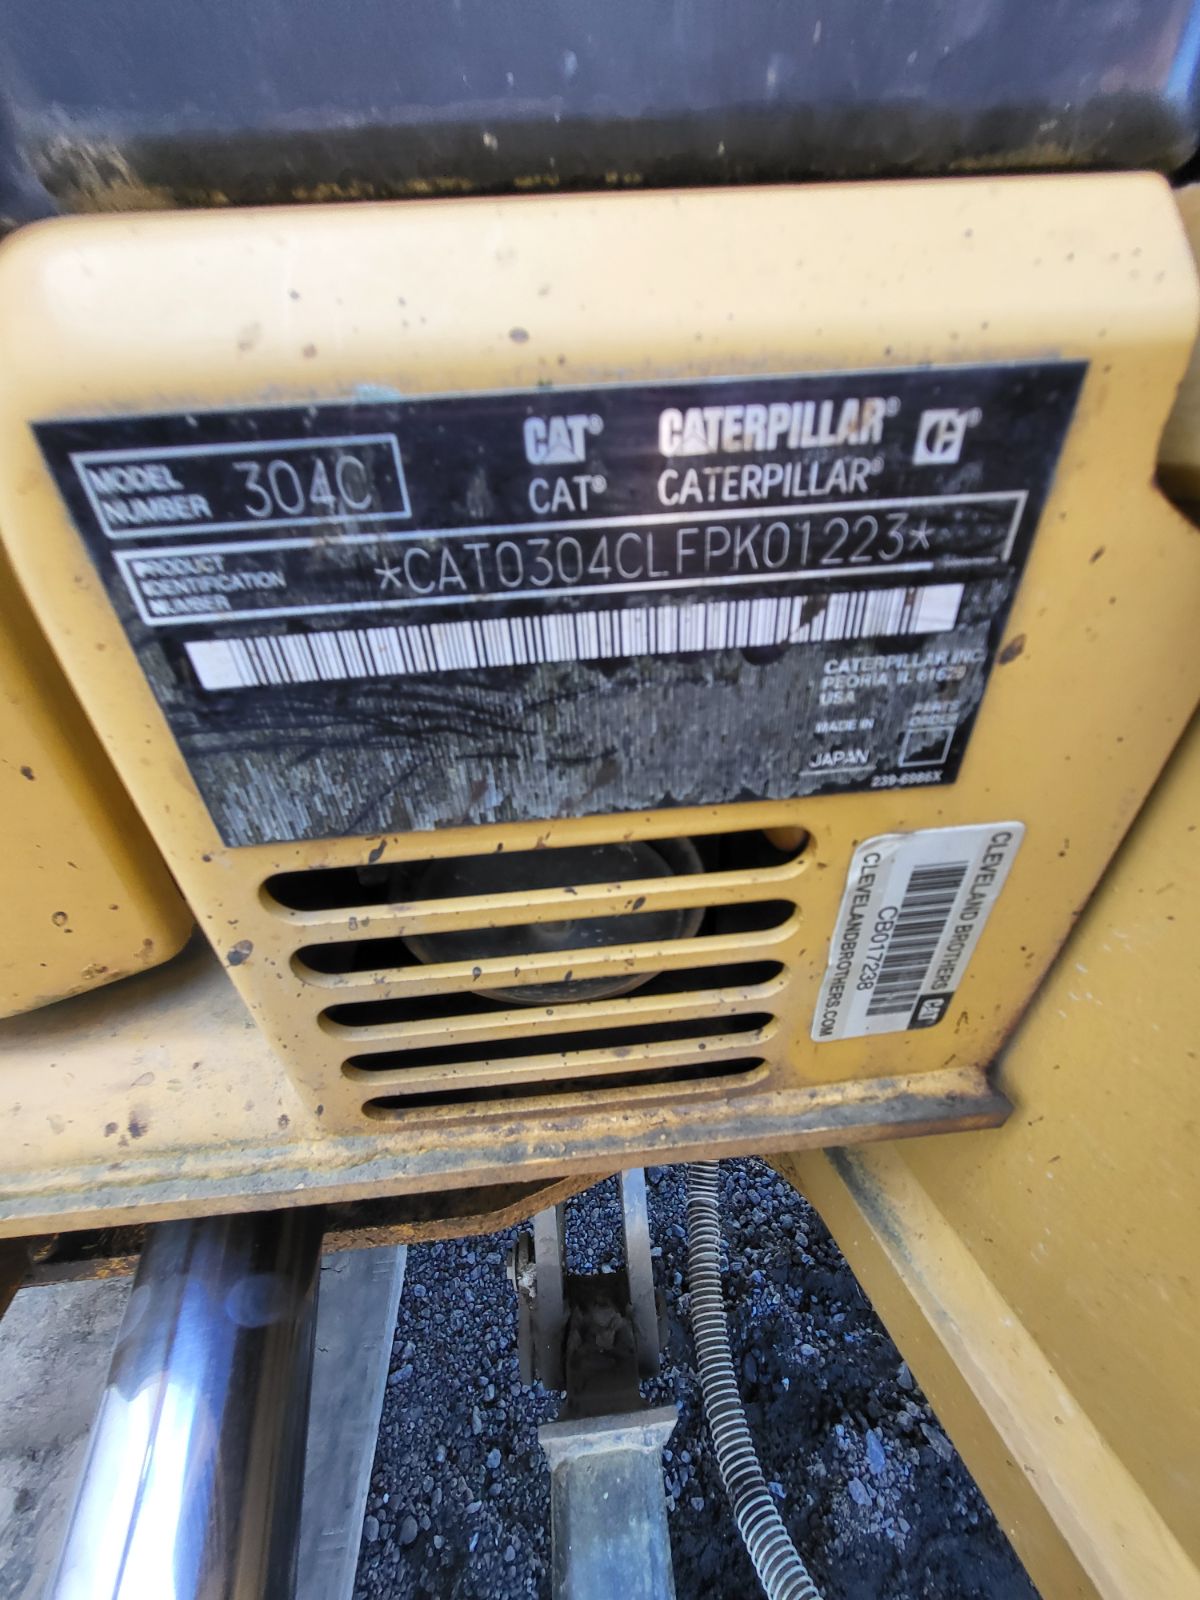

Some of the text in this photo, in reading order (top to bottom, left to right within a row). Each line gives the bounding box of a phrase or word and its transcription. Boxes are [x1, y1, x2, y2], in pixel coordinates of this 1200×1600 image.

[85, 464, 185, 494] MODEL
[232, 456, 373, 518] 304C
[101, 494, 214, 524] NUMBER
[140, 571, 288, 596] IDENTIFICATION
[824, 653, 949, 673] CATERPILLAR
[821, 672, 889, 690] PEORIA
[815, 718, 874, 733] MADE IN
[808, 749, 871, 769] JAPAN
[931, 831, 1014, 991] CLEVELAND BROTHERS
[819, 852, 881, 1037] CLEVELANDBROTHERS.COM
[856, 905, 899, 991] CB017238
